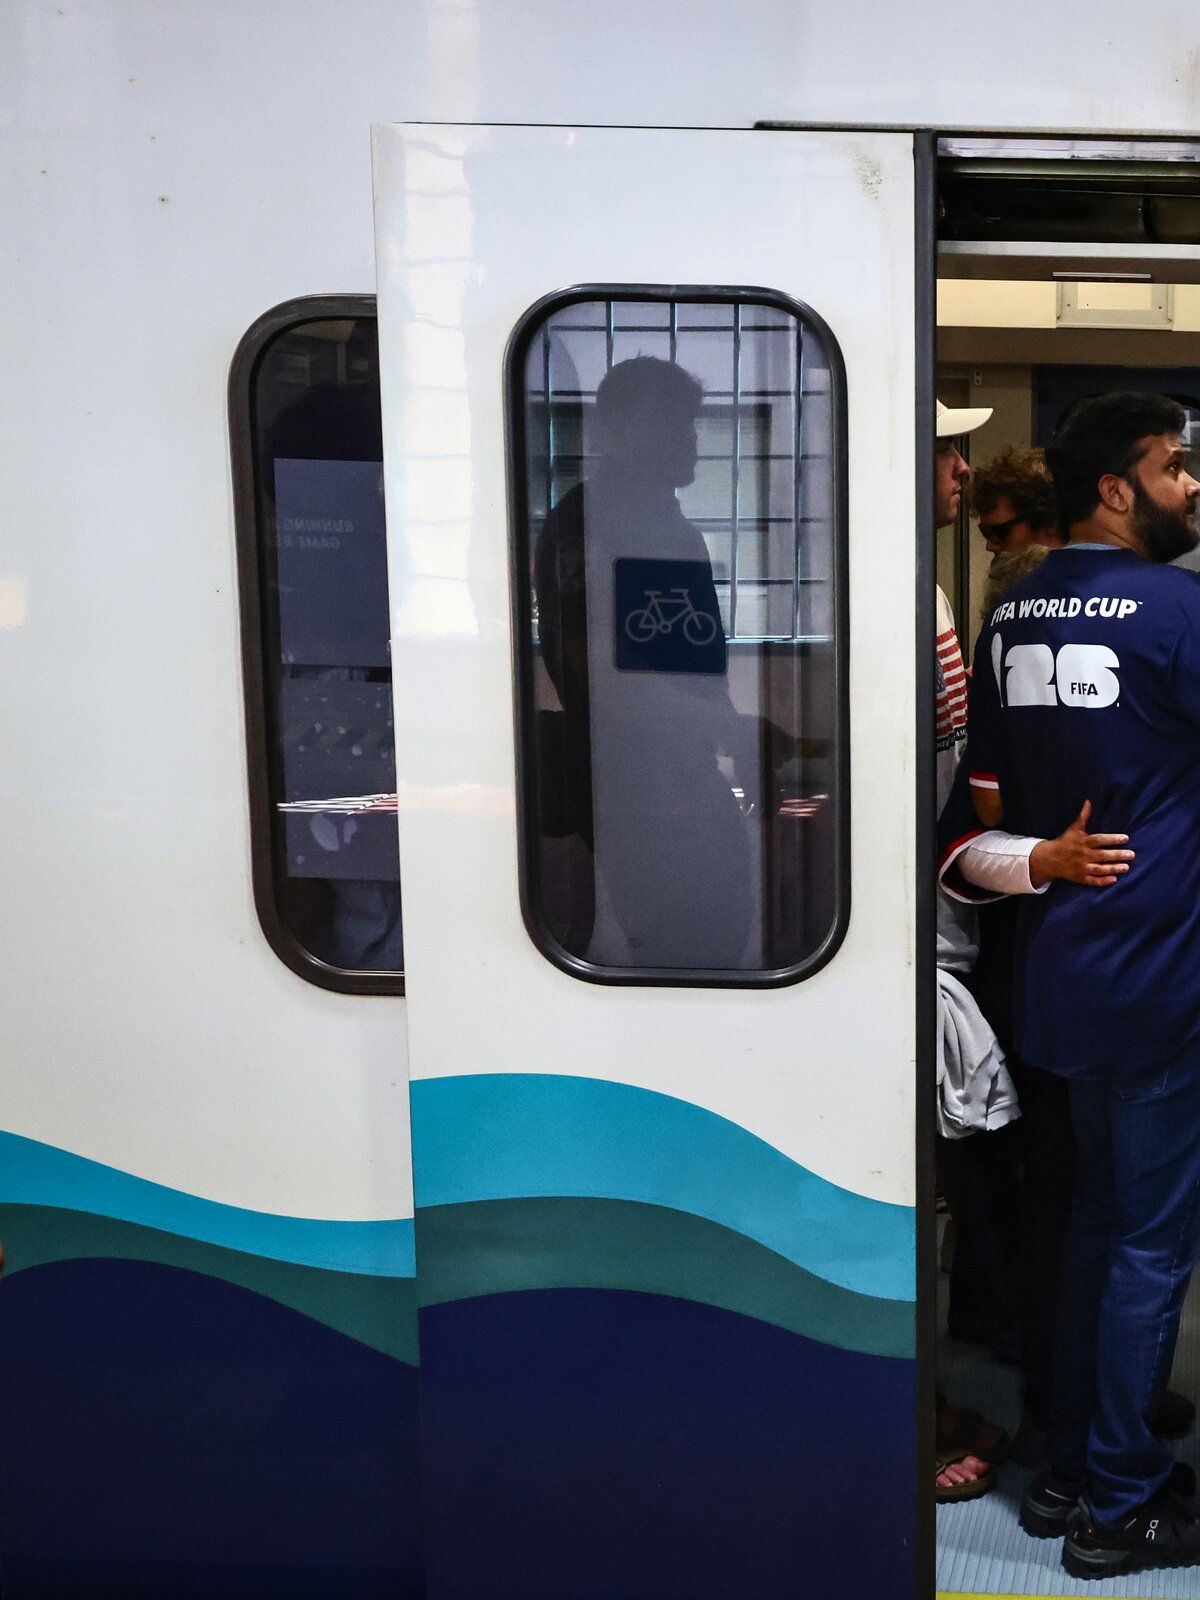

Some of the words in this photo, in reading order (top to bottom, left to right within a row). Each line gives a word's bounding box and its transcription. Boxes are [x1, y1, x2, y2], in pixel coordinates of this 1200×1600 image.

[990, 601, 1015, 627] FIFA
[1018, 597, 1081, 618] WORLD
[1070, 682, 1099, 696] FIFA
